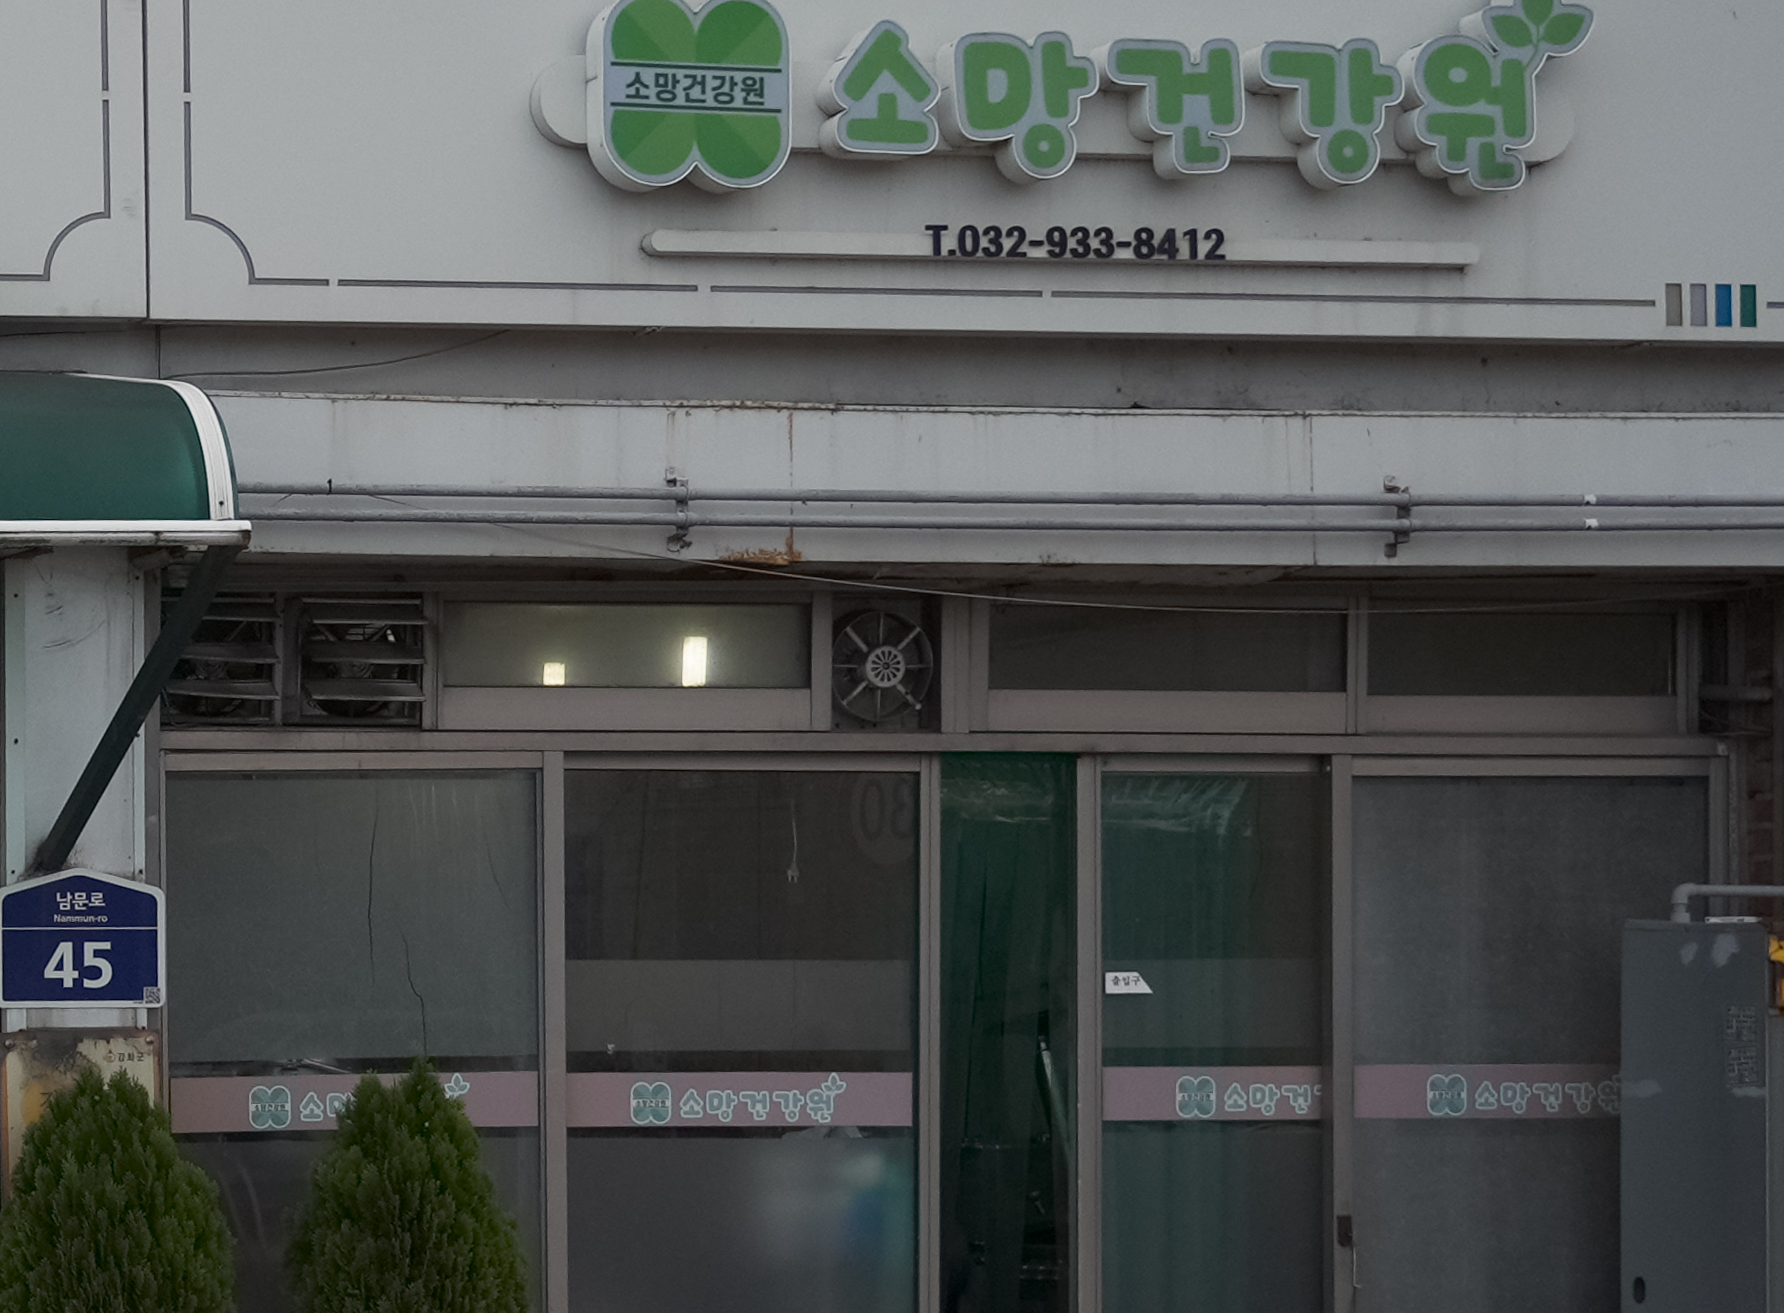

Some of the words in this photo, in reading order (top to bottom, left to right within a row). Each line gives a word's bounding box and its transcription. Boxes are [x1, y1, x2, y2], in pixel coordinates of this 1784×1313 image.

[623, 71, 766, 107] 소망건강원
[838, 31, 1527, 181] 소망건강원
[926, 224, 1227, 262] T.032-933-8412
[53, 914, 108, 923] Nammun-ro
[56, 892, 106, 910] 남문로
[44, 941, 113, 988] 45
[680, 1089, 834, 1123] 소망건강원
[1224, 1082, 1322, 1116] 소망건
